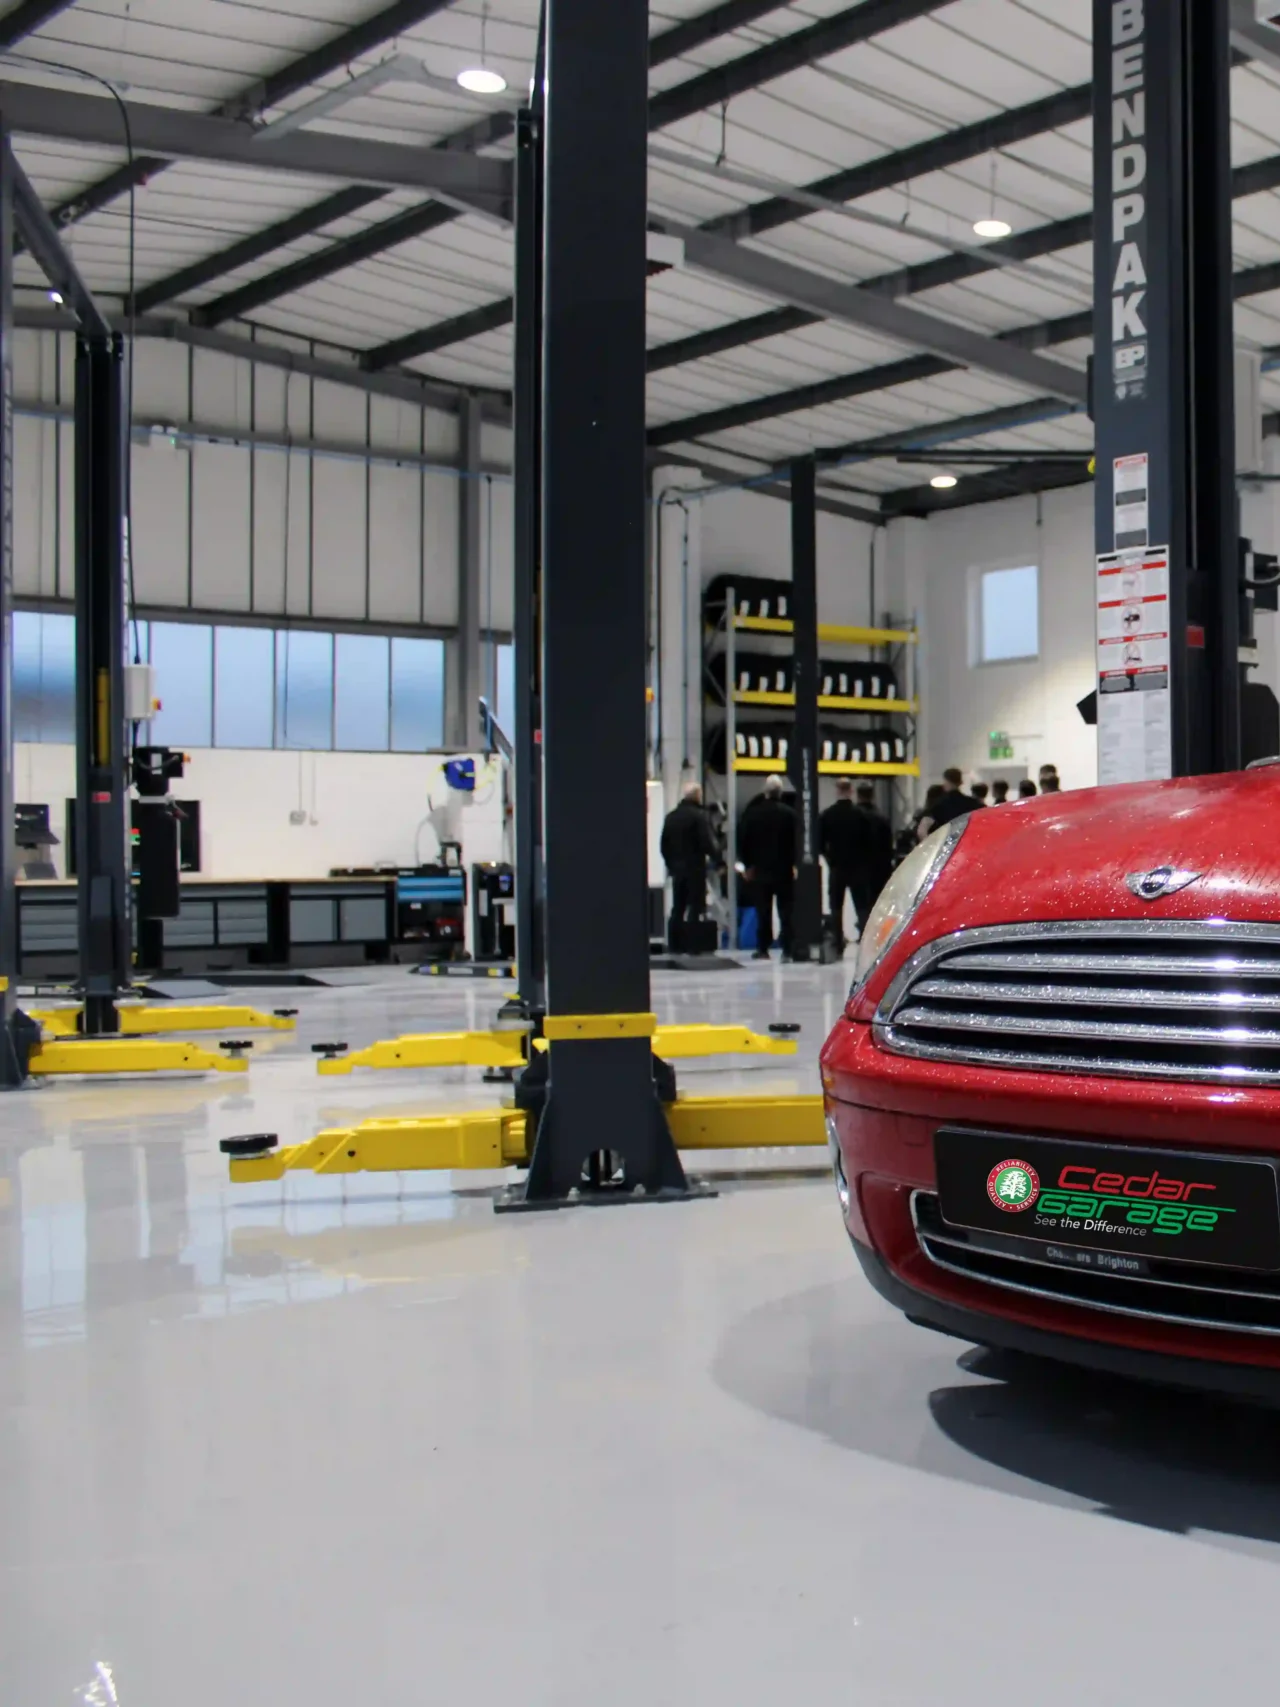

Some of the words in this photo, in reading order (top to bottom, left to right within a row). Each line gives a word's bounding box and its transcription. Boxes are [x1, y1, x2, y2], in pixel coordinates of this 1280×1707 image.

[1112, 0, 1147, 341] BENDPAK
[996, 1161, 1036, 1177] RELIABILITY
[988, 1181, 1007, 1208] QUALITY
[1058, 1166, 1216, 1201] Cedar
[1016, 1188, 1038, 1210] SERVICE
[1034, 1213, 1057, 1227] See
[1060, 1216, 1081, 1229] the
[1083, 1219, 1147, 1236] Difference
[1037, 1194, 1218, 1234] Garage
[1097, 1254, 1140, 1270] Brighton
